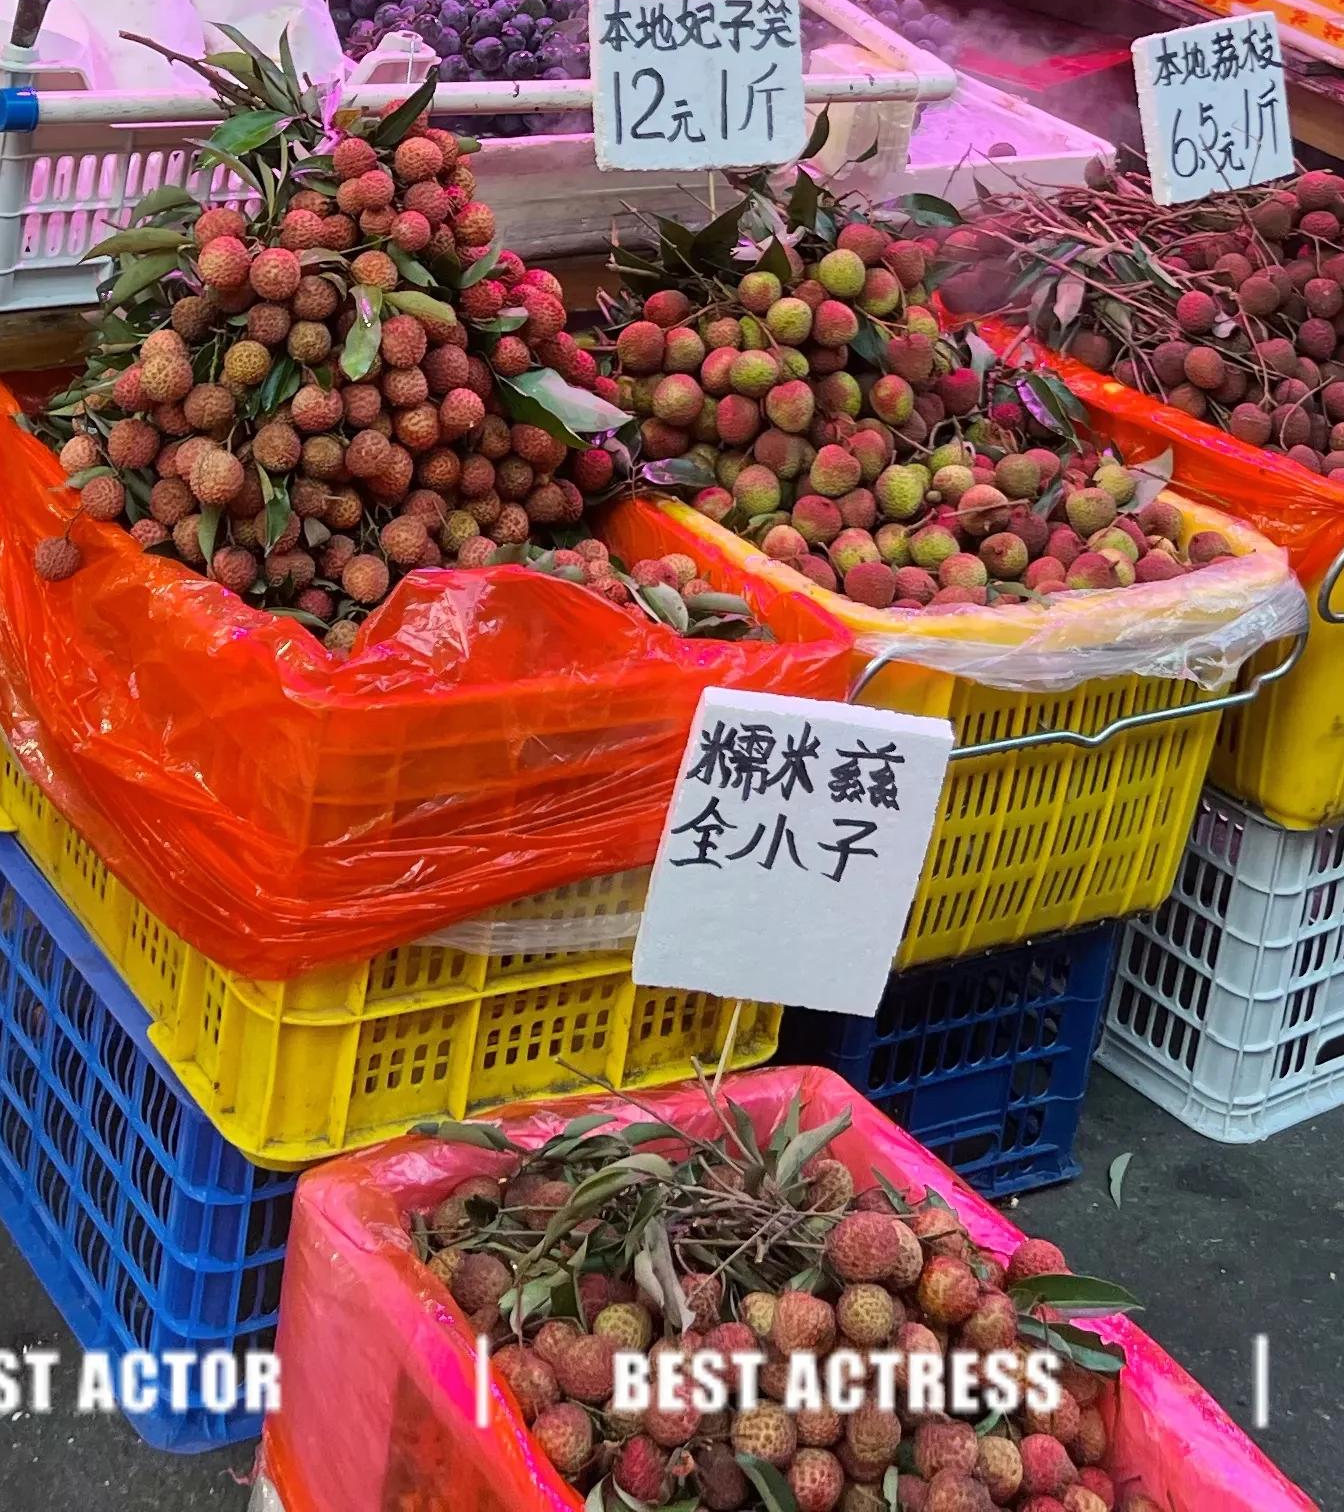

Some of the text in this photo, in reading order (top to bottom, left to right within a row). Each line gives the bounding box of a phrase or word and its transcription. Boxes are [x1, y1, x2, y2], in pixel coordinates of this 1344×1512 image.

[1153, 19, 1284, 86] 本地荔枝
[669, 795, 879, 882] 全小子
